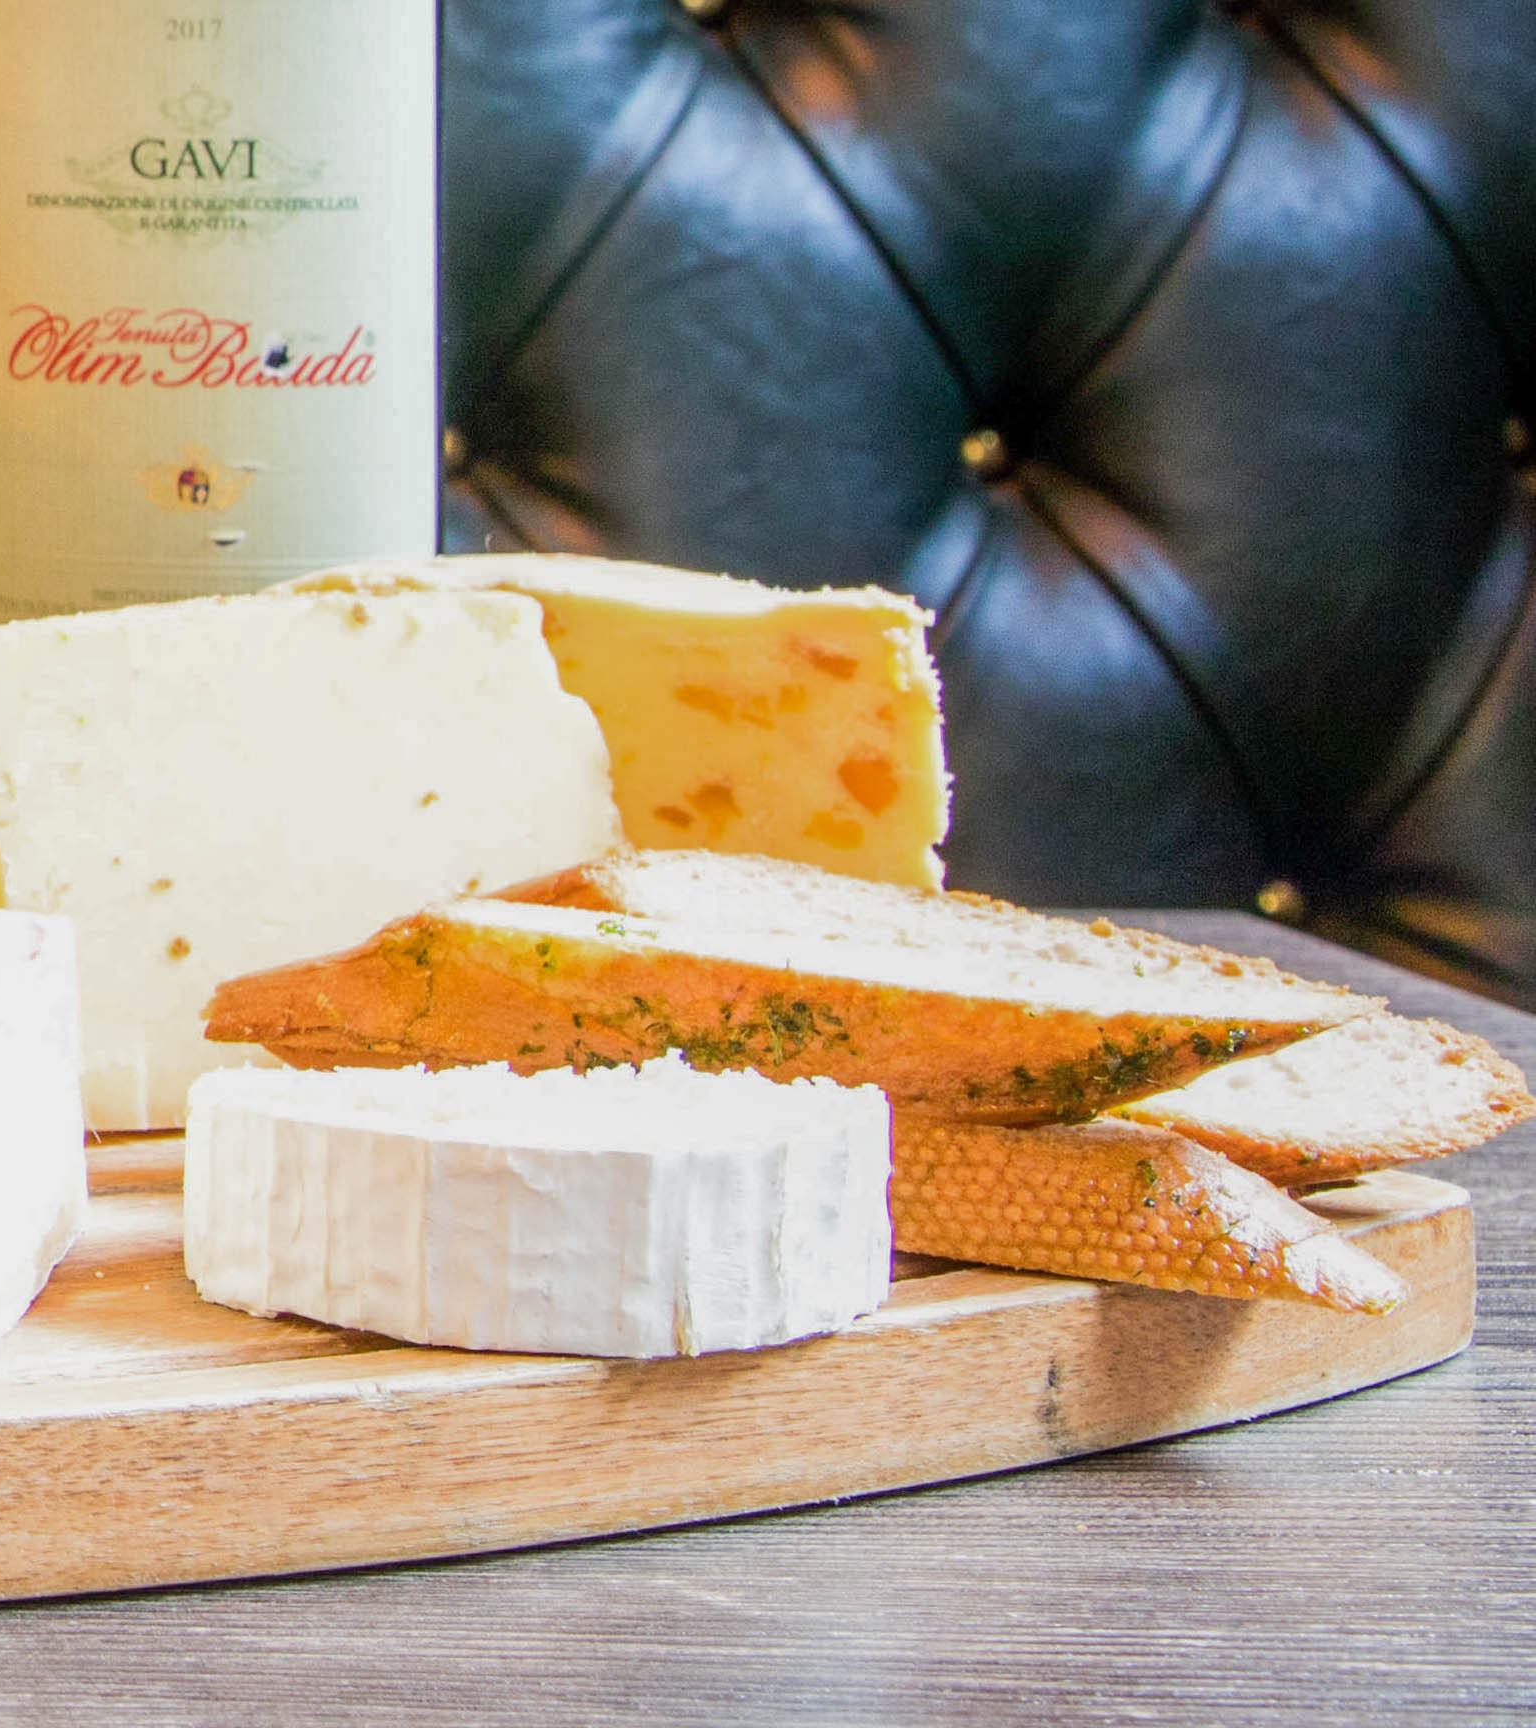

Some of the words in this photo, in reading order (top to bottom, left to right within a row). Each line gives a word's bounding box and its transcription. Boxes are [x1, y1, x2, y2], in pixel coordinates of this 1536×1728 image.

[164, 18, 222, 41] 2017
[130, 138, 259, 180] GAVI
[8, 302, 147, 384] Olim
